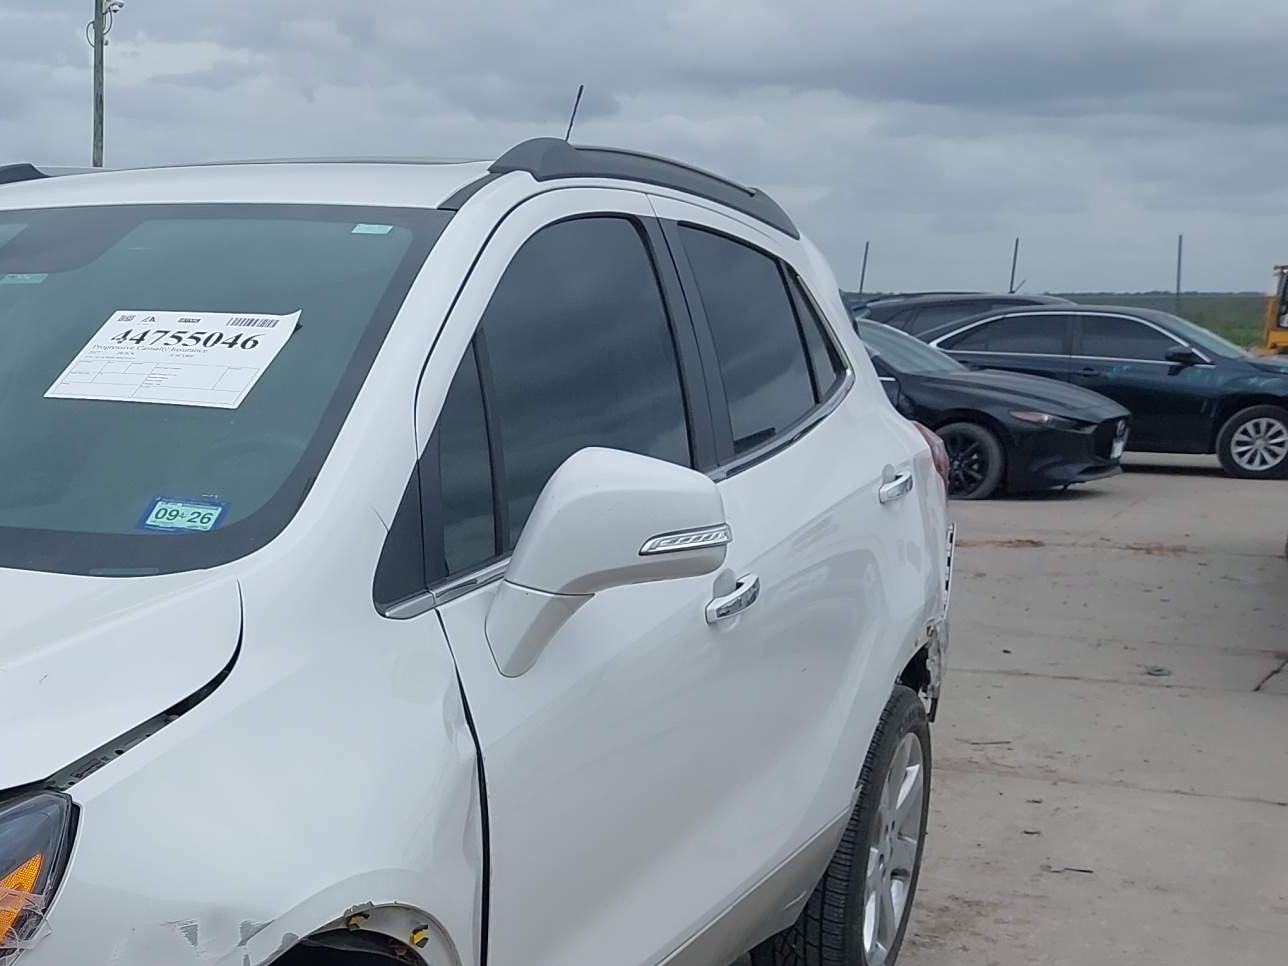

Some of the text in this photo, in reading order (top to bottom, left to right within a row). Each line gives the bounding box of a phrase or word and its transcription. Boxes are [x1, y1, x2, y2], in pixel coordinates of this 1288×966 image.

[111, 329, 266, 350] 44755046
[155, 508, 213, 524] 09 26
